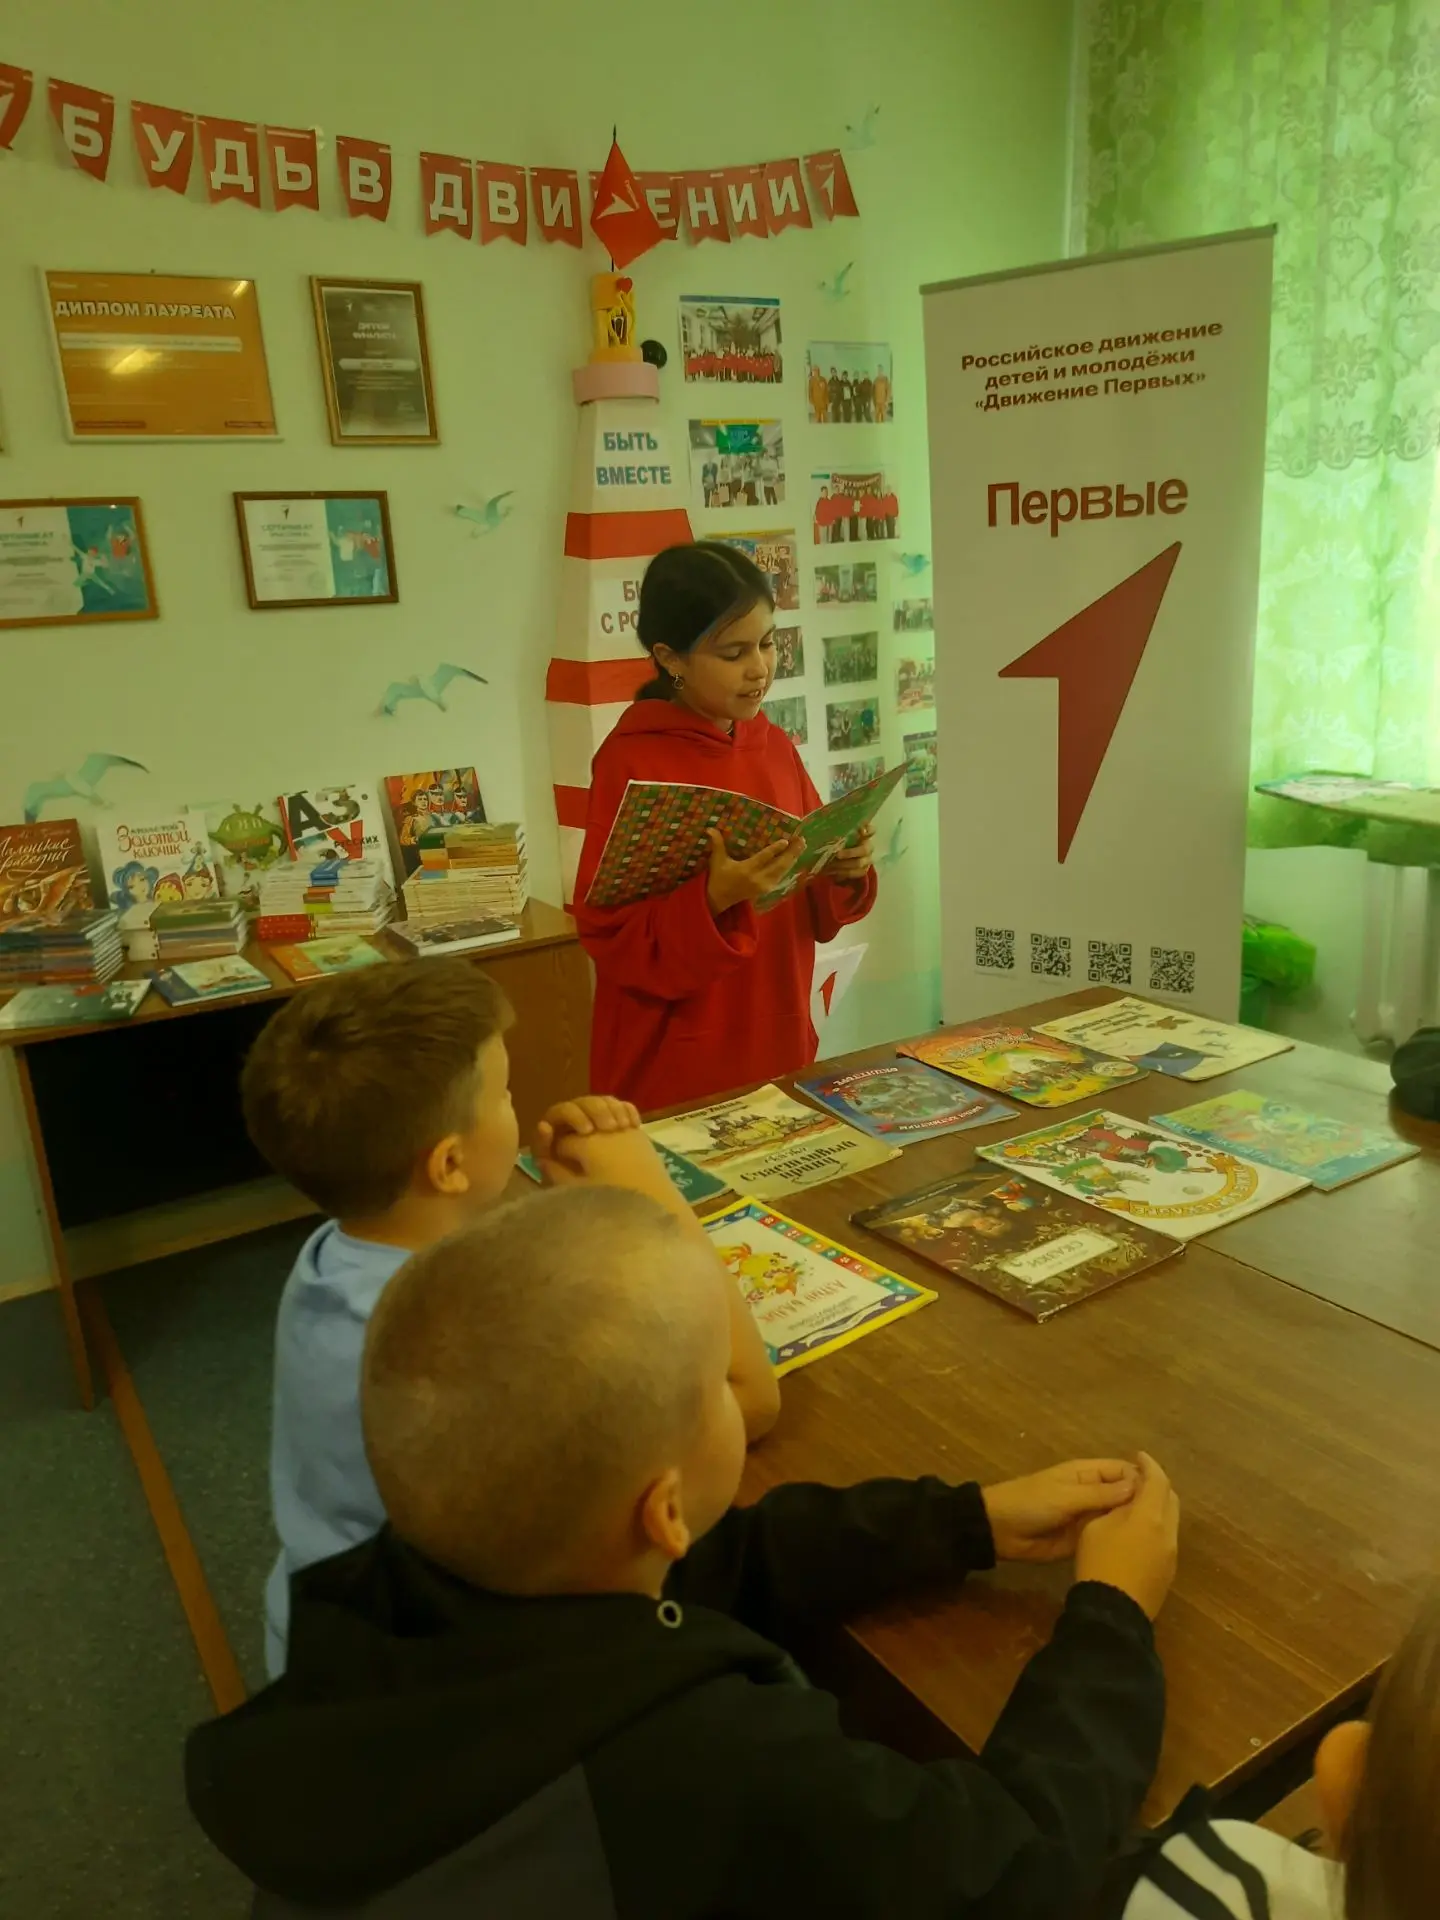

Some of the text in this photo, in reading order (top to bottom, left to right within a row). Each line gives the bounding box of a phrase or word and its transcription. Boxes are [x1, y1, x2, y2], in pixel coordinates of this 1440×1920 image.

[62, 103, 801, 230] БУДЬ В ДВИЕНИИ
[55, 300, 235, 320] ДИПЛОМ ЛАУРЕАТА
[961, 322, 1223, 371] Российское движение
[985, 349, 1195, 390] детей и молодёжи
[975, 371, 1206, 411] «Движение Первых»
[603, 432, 658, 451] БЫТЬ
[596, 465, 672, 486] ВМЕСТЕ
[987, 478, 1188, 537] Первые
[600, 612, 614, 635] С
[740, 1139, 858, 1183] Счастливый
[779, 1157, 841, 1182] принц
